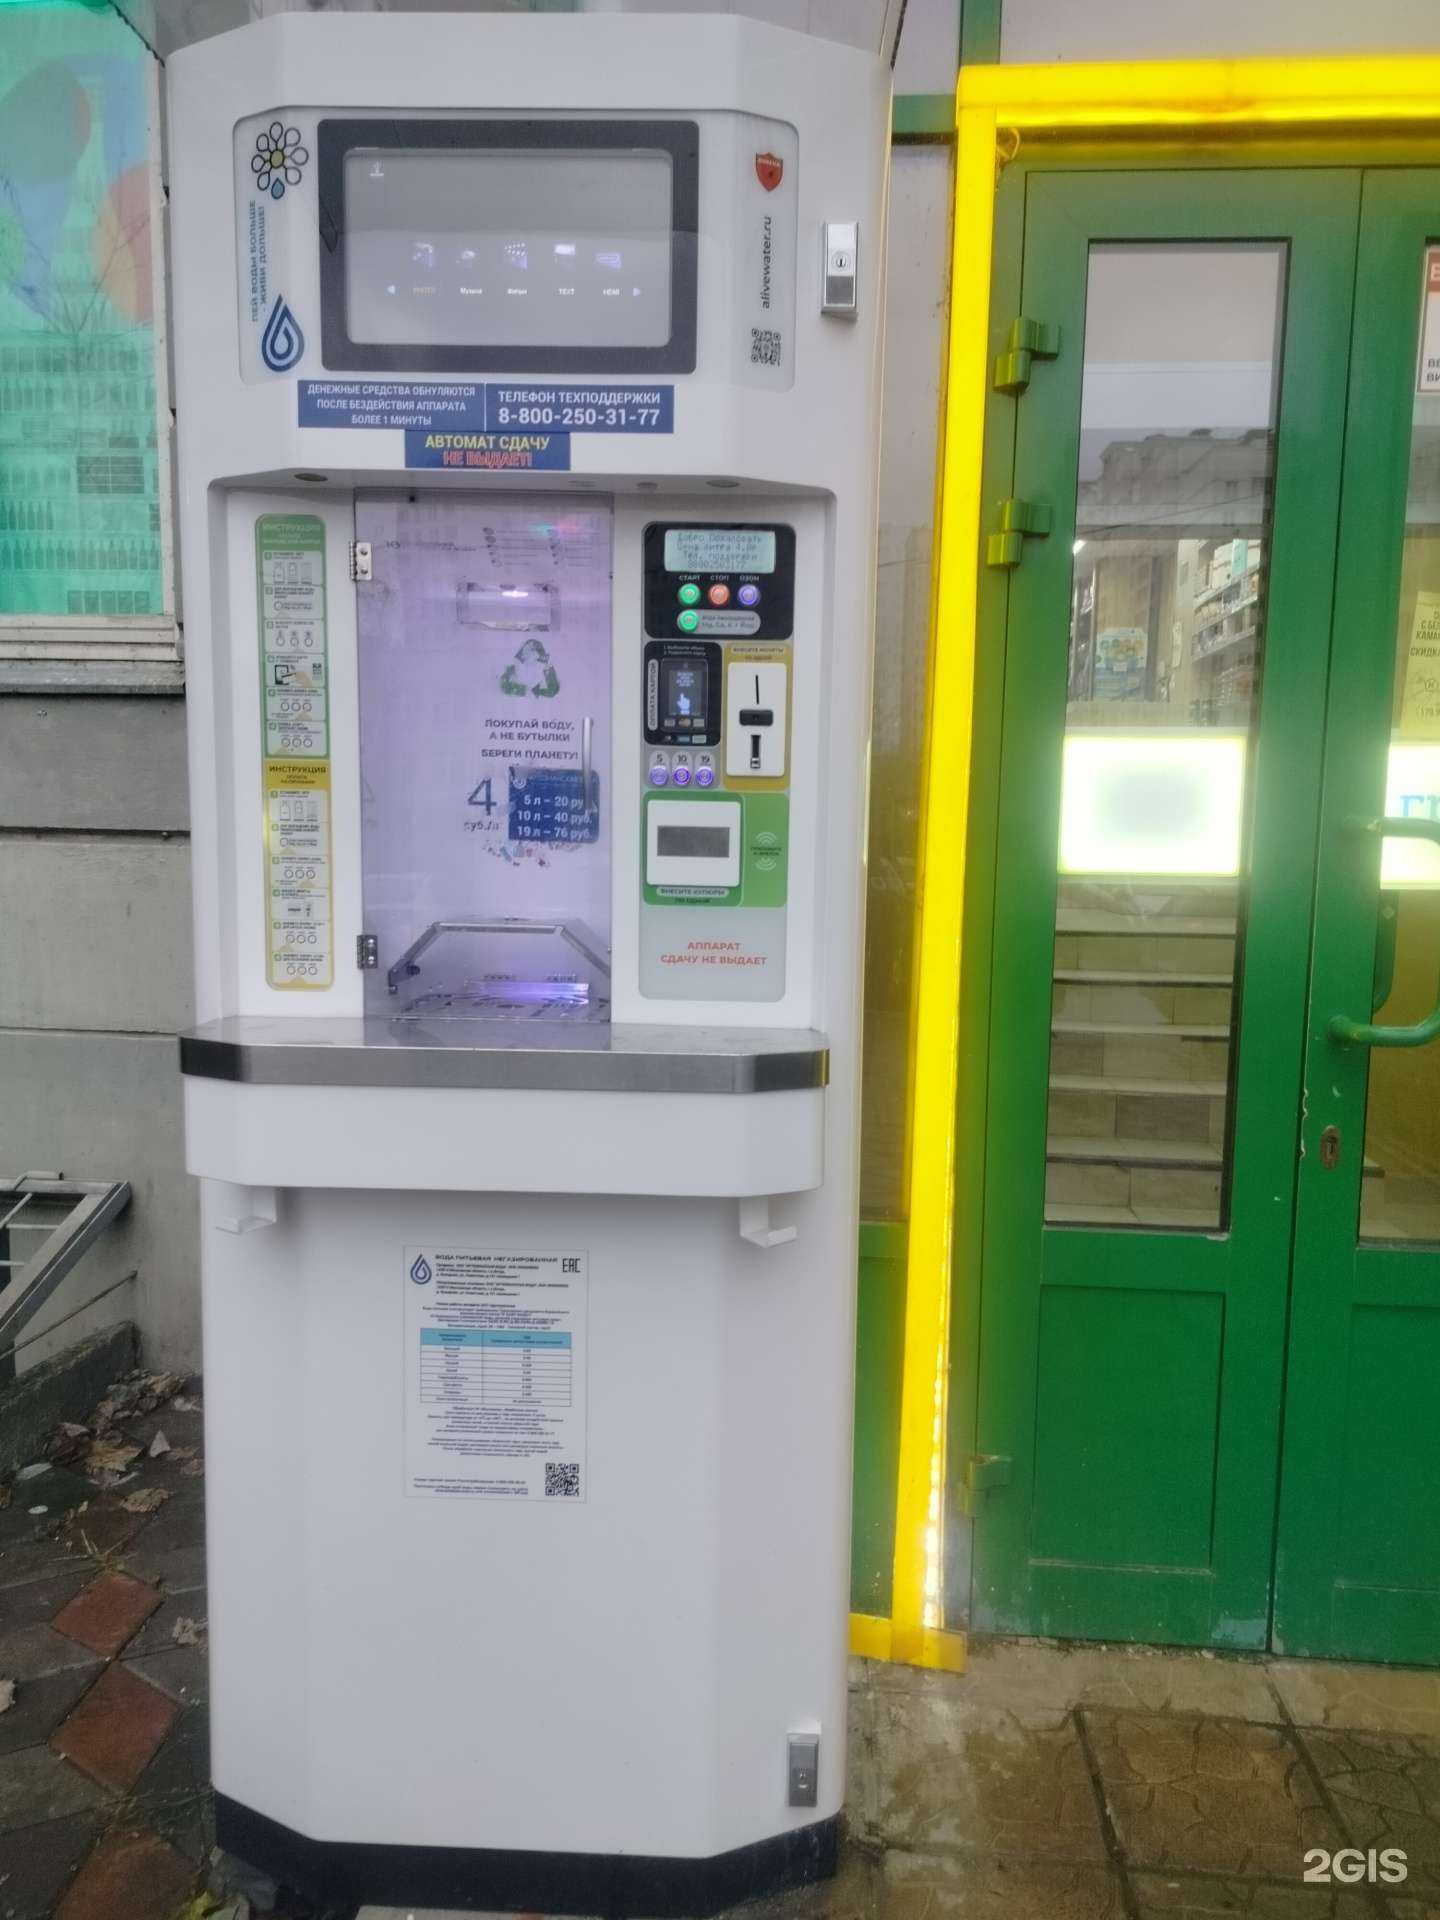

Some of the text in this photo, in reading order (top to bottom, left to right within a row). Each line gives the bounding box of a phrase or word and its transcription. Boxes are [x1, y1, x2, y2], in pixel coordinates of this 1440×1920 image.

[760, 215, 772, 310] alivewater.ru
[307, 383, 476, 397] ДЕНЕЖНЫЕ СРЕДСТВА ОБНУЛЯЮТСЯ
[317, 398, 467, 411] ПОСЛЕ БЕЗДЕЙСТВИЯ АППАРАТА
[498, 391, 661, 406] ТЕЛЕФОН ТЕХПОДДЕРЖКИ
[351, 415, 382, 424] БОЛЕЕ
[390, 415, 432, 425] МИНУТЫ
[498, 408, 661, 426] 8-800-250-31-77
[425, 435, 550, 452] АВТОМАТ СДАЧУ
[443, 451, 464, 465] НЕ
[484, 718, 575, 731] ПОКУПАЙ ВОДУ,
[489, 732, 570, 742] А НЕ БУТЫЛКИ
[481, 749, 579, 760] БЕРЕГИ ПЛАНЕТУ!
[656, 754, 663, 763] 5
[678, 754, 687, 763] 10
[268, 765, 327, 774] ИНСТРУКЦИЯ
[467, 777, 497, 816] 4
[523, 794, 532, 805] 5
[533, 796, 541, 805] л
[554, 796, 569, 807] 20
[517, 810, 529, 822] 10
[533, 813, 541, 822] л
[554, 812, 569, 823] 40
[517, 825, 529, 837] 19
[533, 829, 541, 837] л
[554, 827, 569, 838] 76
[570, 828, 593, 840] руб.
[687, 942, 742, 951] АППАРАТ
[660, 954, 768, 966] СДАЧУ НЕ ВЫДАЕТ
[455, 1254, 491, 1262] ПИТЬЕВАЯ
[493, 1255, 558, 1263] НЕГАЗИРОВАННАЯ
